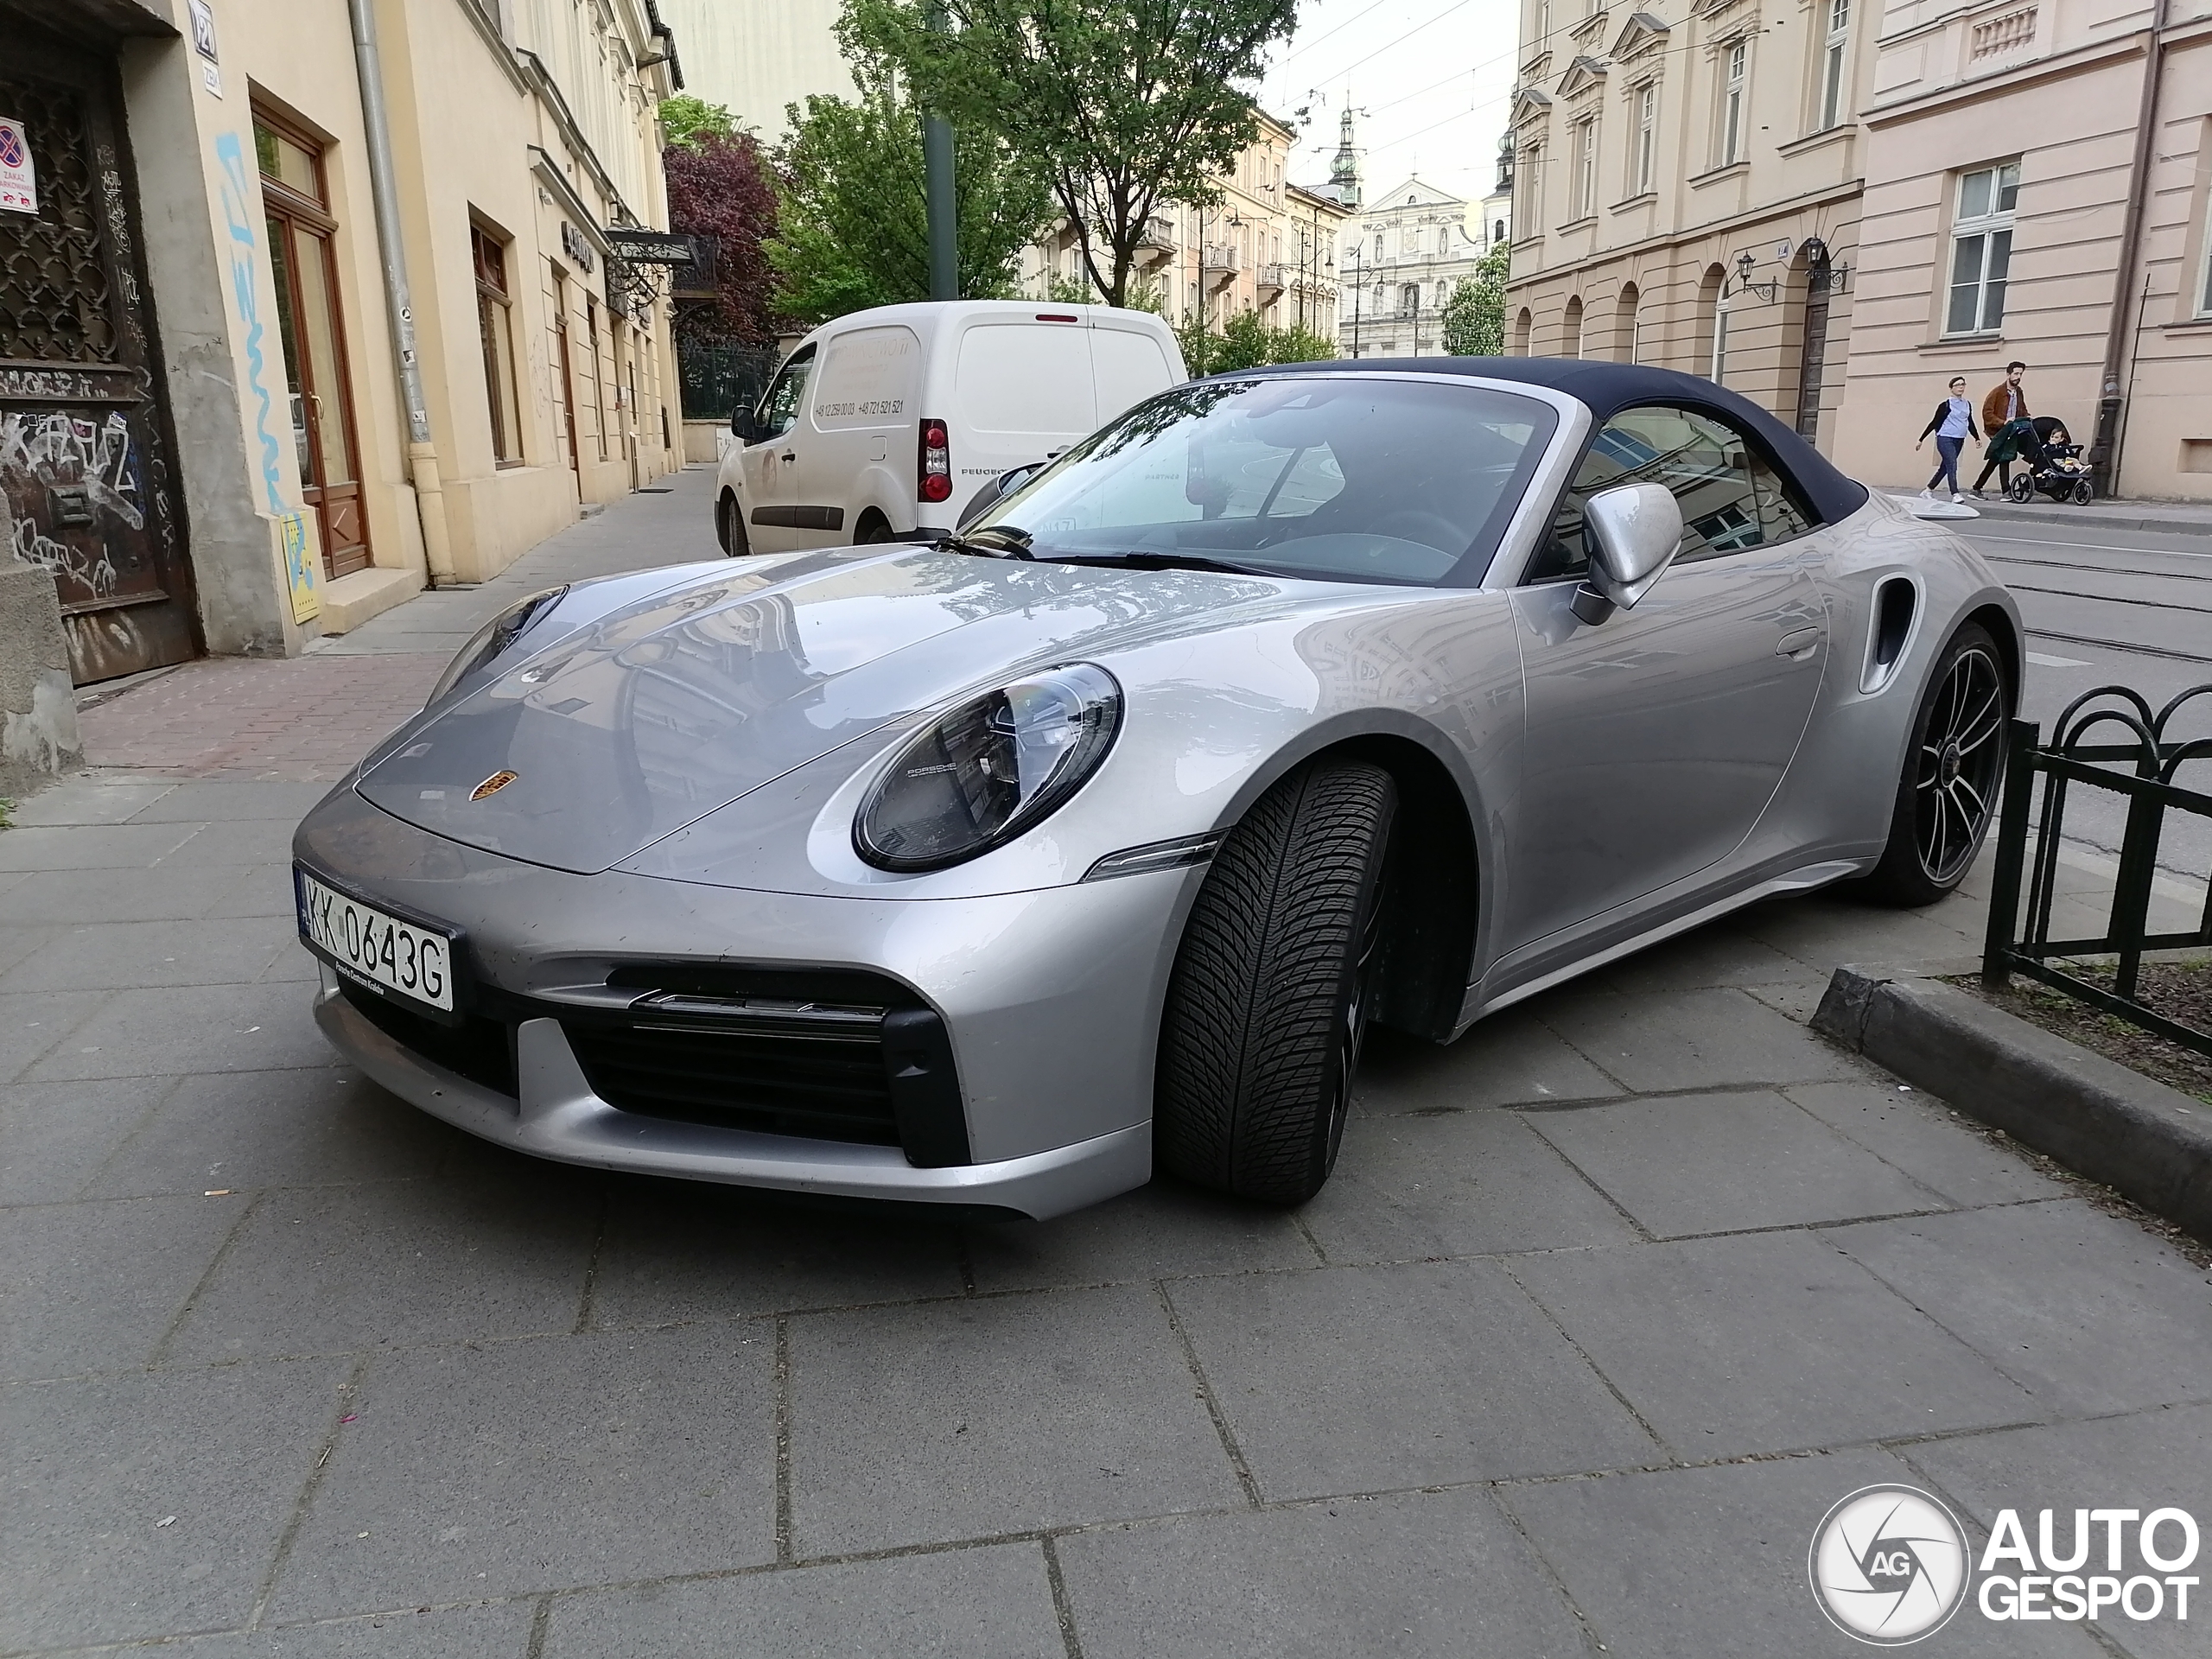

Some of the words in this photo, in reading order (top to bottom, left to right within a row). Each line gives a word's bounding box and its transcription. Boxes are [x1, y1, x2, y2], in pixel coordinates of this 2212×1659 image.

[3, 171, 25, 182] ZAKAZ
[0, 179, 34, 192] ARKOWANIA
[816, 404, 824, 416] +48
[825, 404, 830, 416] 12
[830, 404, 841, 416] 259
[841, 403, 848, 415] 00
[848, 403, 855, 415] 03
[859, 401, 868, 415] +48
[869, 401, 880, 414] 721
[880, 400, 891, 414] 521
[892, 400, 903, 413] 521
[907, 762, 957, 773] PORSCHE
[308, 881, 338, 952] KK
[346, 905, 442, 999] 0643G
[335, 960, 350, 977] Porsche
[350, 969, 367, 987] Centrum
[367, 979, 385, 995] Kraków
